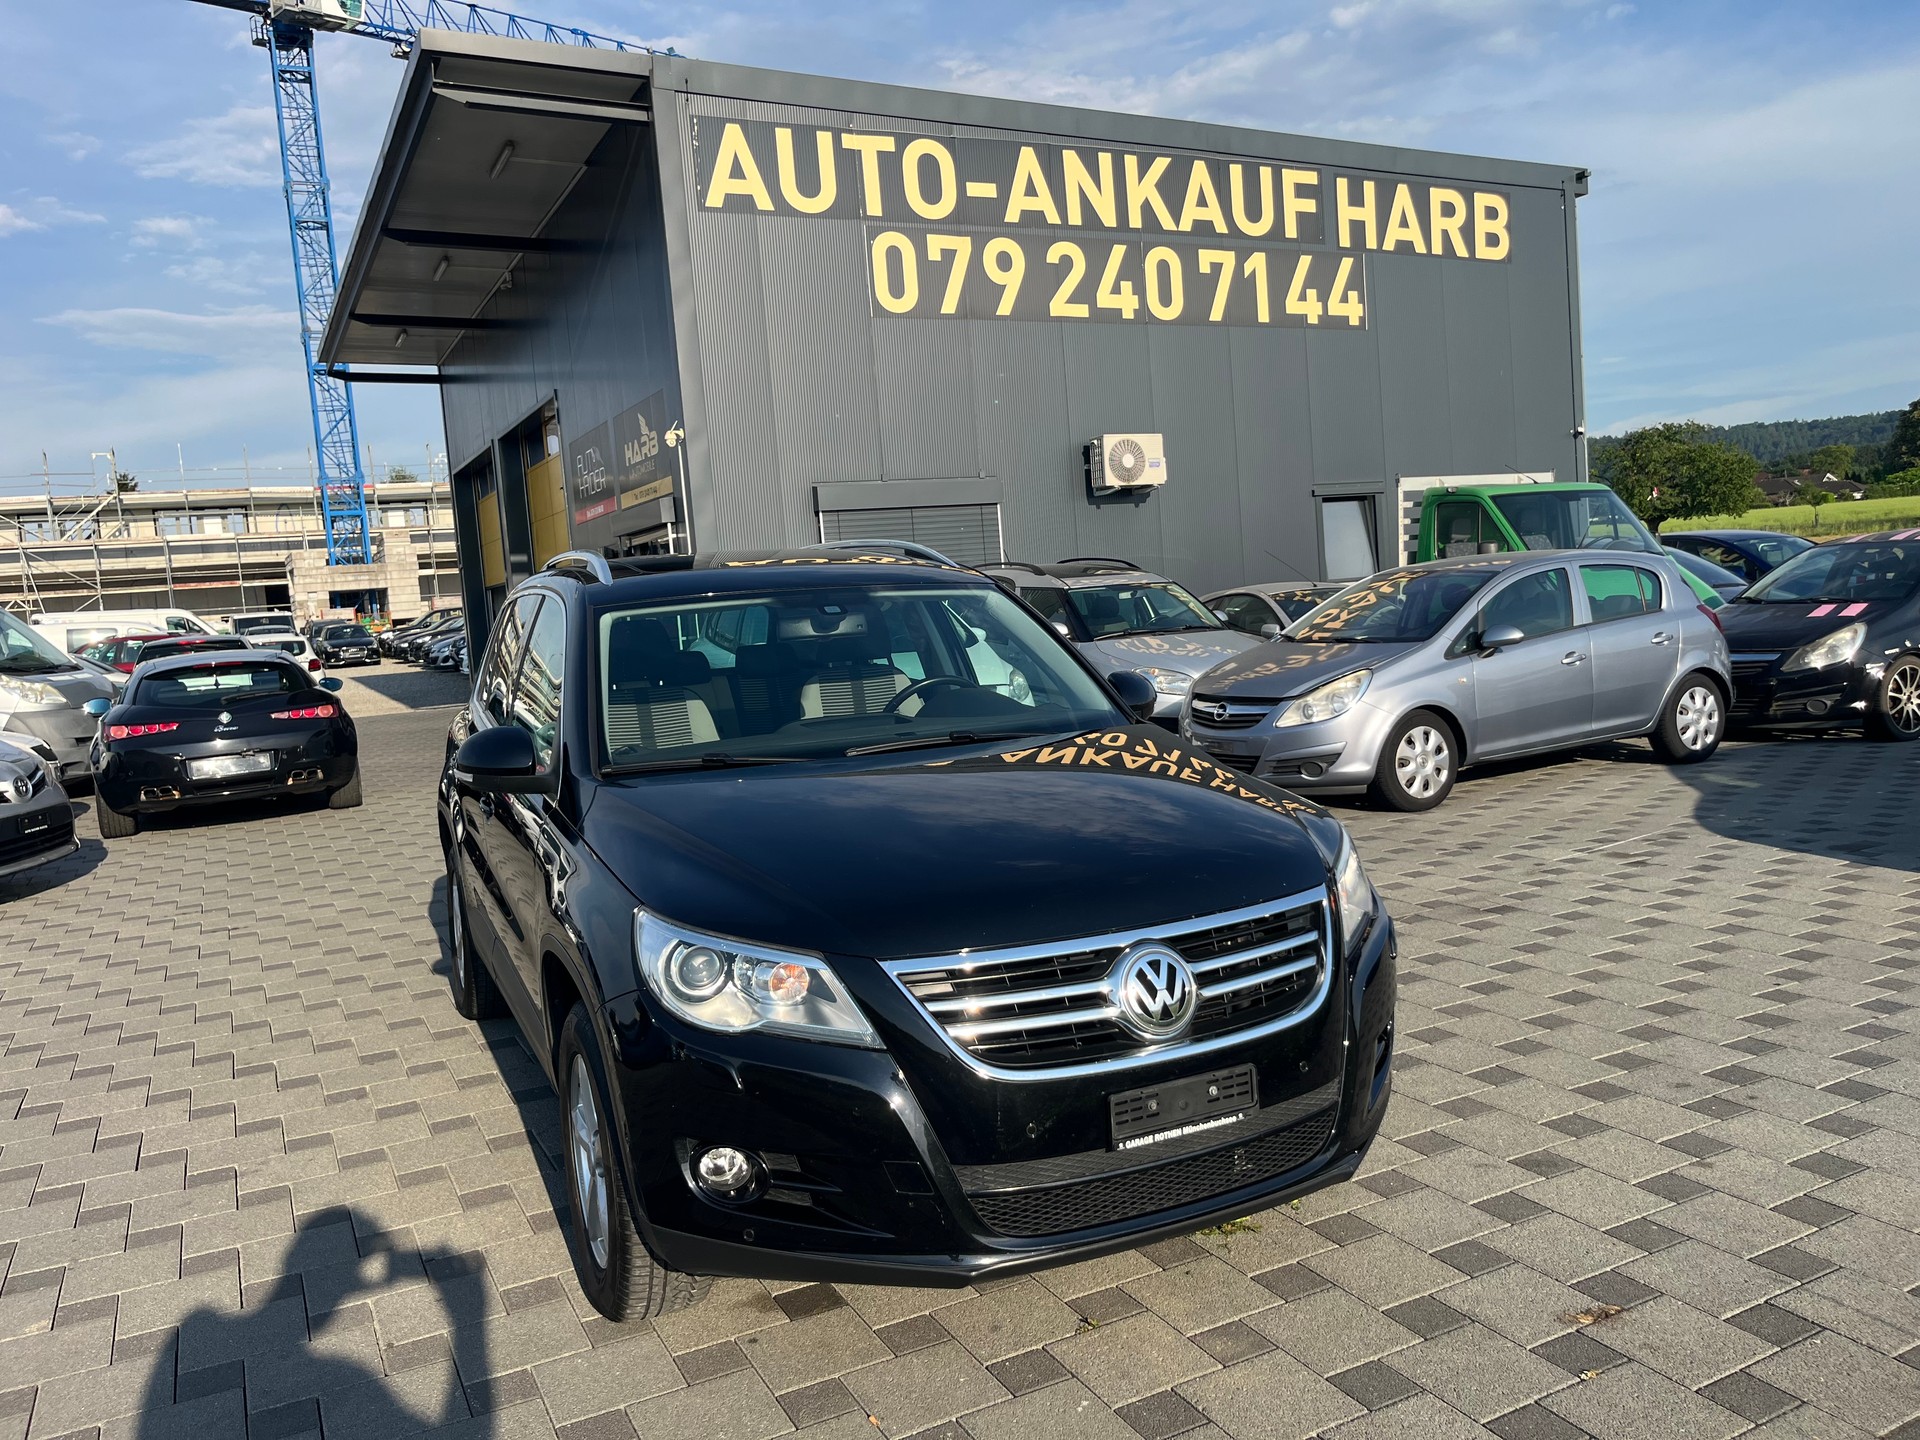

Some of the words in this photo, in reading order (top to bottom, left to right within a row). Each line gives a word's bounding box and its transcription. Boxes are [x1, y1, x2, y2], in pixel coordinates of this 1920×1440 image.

[705, 122, 1319, 239] AUTO-ANKAUF
[1335, 176, 1511, 261] HARB
[871, 230, 1026, 317] 079
[1045, 240, 1185, 323] 240
[1198, 248, 1271, 324] 71
[1285, 253, 1365, 326] 44
[624, 430, 659, 467] HARB
[1125, 1134, 1154, 1149] GARAGE
[1154, 1127, 1182, 1142] ROTHEN
